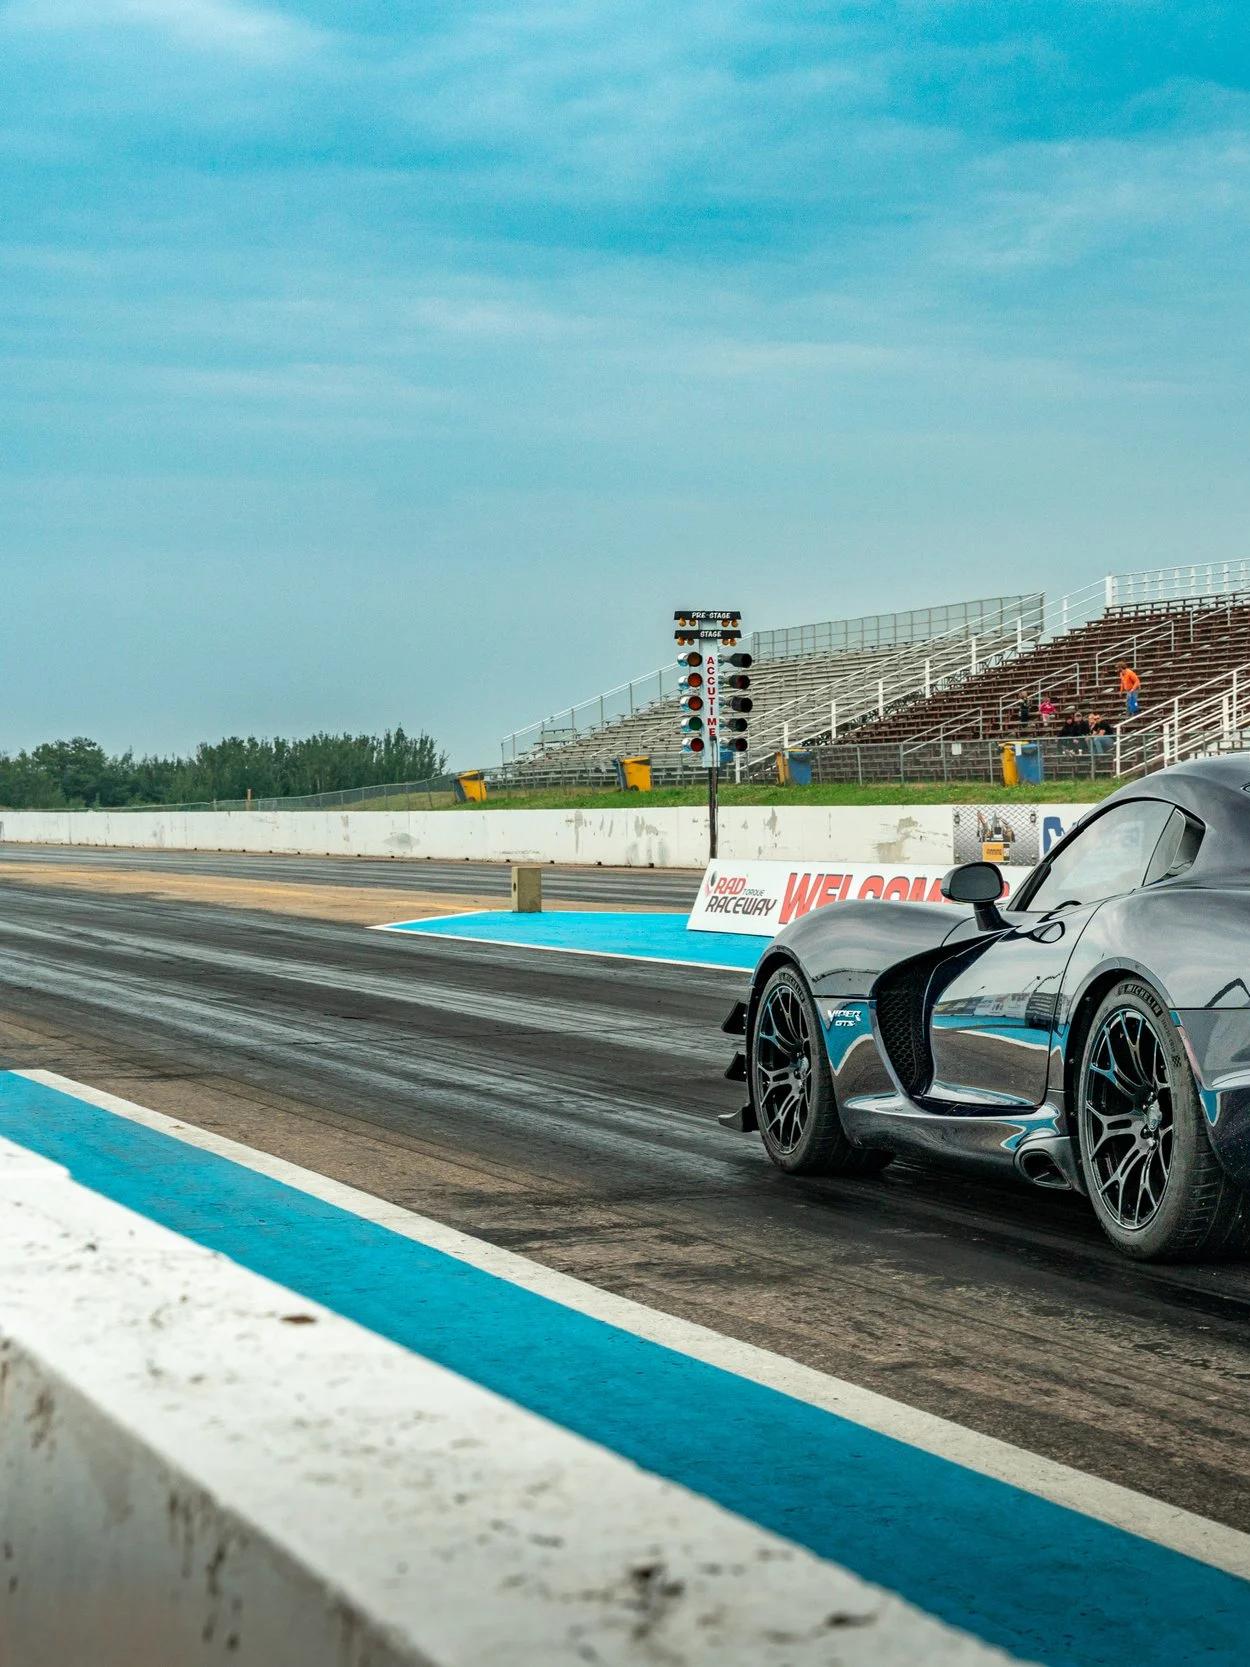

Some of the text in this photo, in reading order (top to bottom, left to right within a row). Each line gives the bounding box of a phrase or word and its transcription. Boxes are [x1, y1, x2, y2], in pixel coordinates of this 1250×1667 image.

[699, 630, 722, 638] STAGE
[706, 656, 717, 737] ACCUTIME
[714, 877, 747, 895] RAD
[743, 888, 766, 896] TORQUE
[705, 895, 778, 916] RACEWAY
[779, 872, 962, 925] WECOM
[827, 1009, 862, 1021] VIPER
